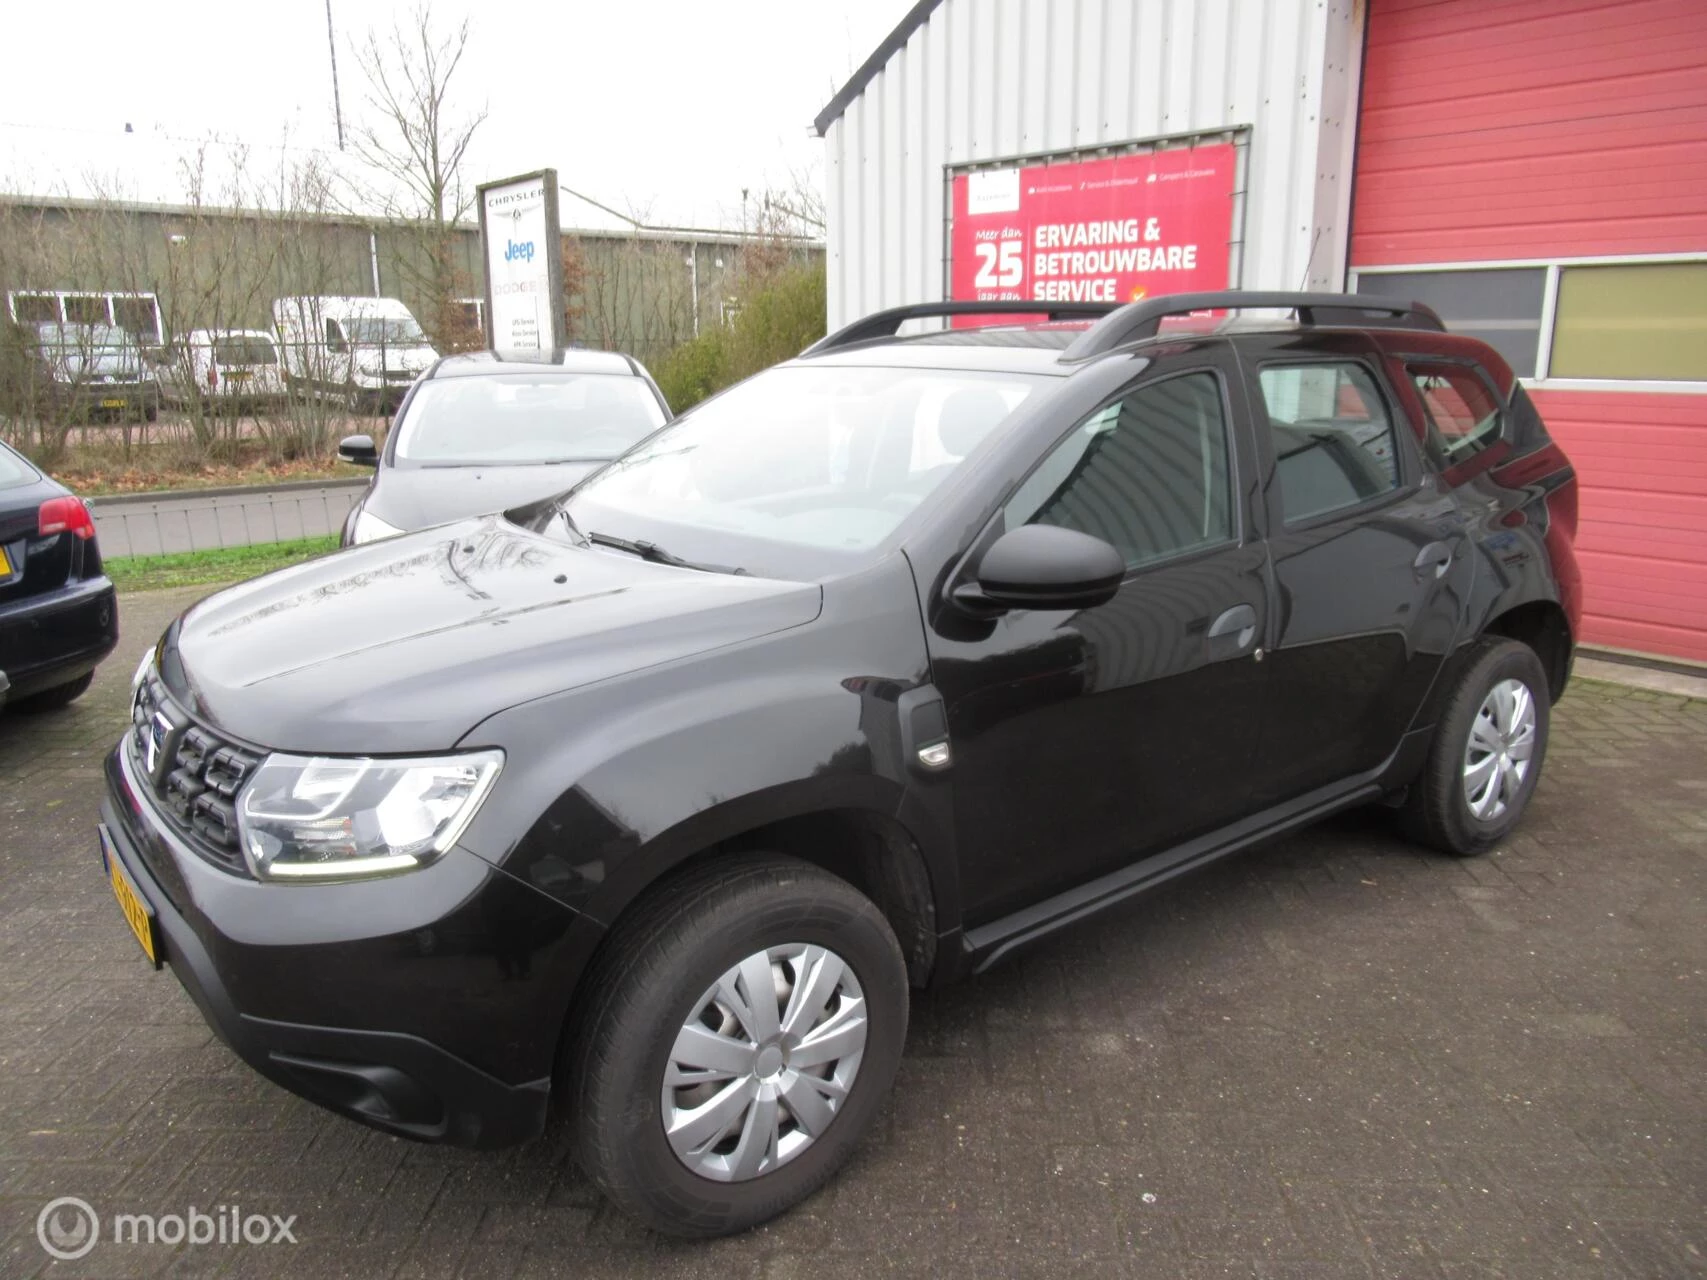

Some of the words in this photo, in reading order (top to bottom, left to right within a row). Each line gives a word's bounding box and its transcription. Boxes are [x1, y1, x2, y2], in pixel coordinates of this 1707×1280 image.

[488, 189, 545, 207] CHRYSLER
[976, 230, 999, 240] Meer
[1001, 226, 1023, 238] dan
[1035, 219, 1138, 248] ERVARING
[1144, 218, 1160, 241] &
[505, 239, 534, 262] Jeep
[1034, 245, 1197, 276] BETROUWBARE
[975, 241, 1023, 288] 25
[495, 280, 537, 296] DODGE
[1033, 278, 1117, 301] SERVICE
